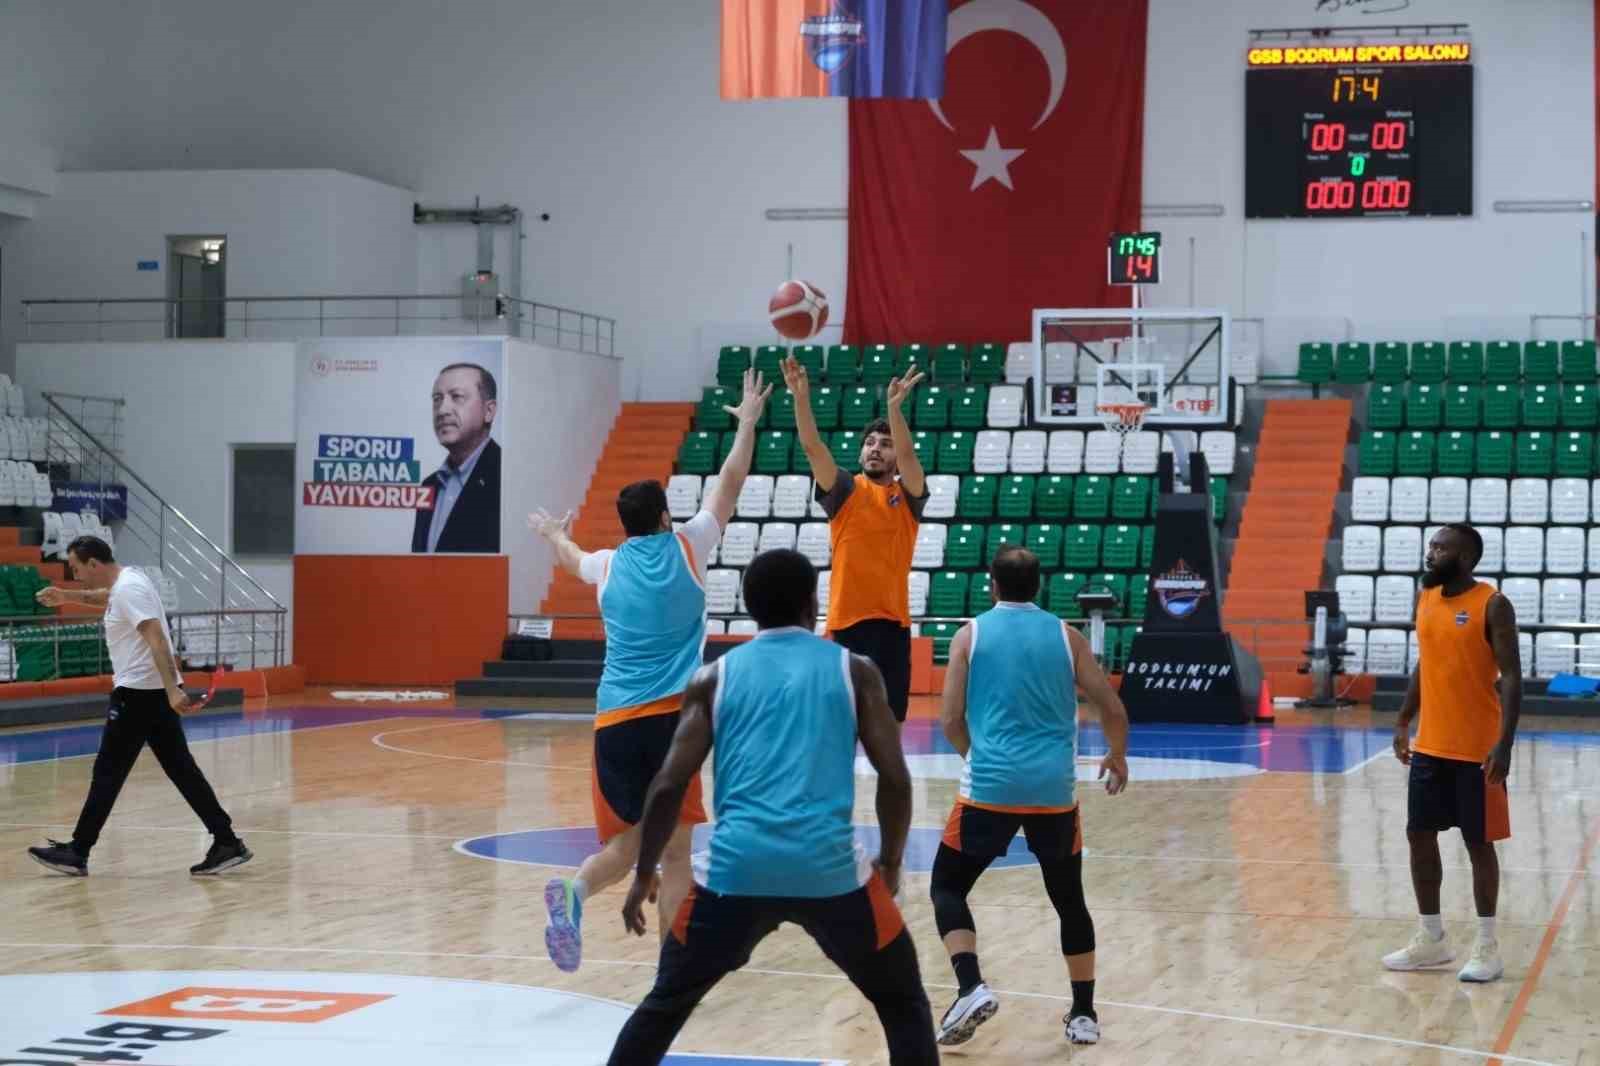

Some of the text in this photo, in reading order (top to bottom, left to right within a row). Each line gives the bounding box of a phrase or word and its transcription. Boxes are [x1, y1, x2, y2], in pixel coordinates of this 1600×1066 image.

[1248, 44, 1469, 65] GSB BODRUM SPOR SALONU
[1311, 123, 1345, 151] 00
[1371, 122, 1405, 150] 00
[1350, 155, 1366, 176] 0
[1306, 181, 1411, 209] 000 000
[326, 438, 402, 460] SPORU
[320, 463, 412, 483] TABANA
[307, 485, 431, 507] YAYIYORUZ
